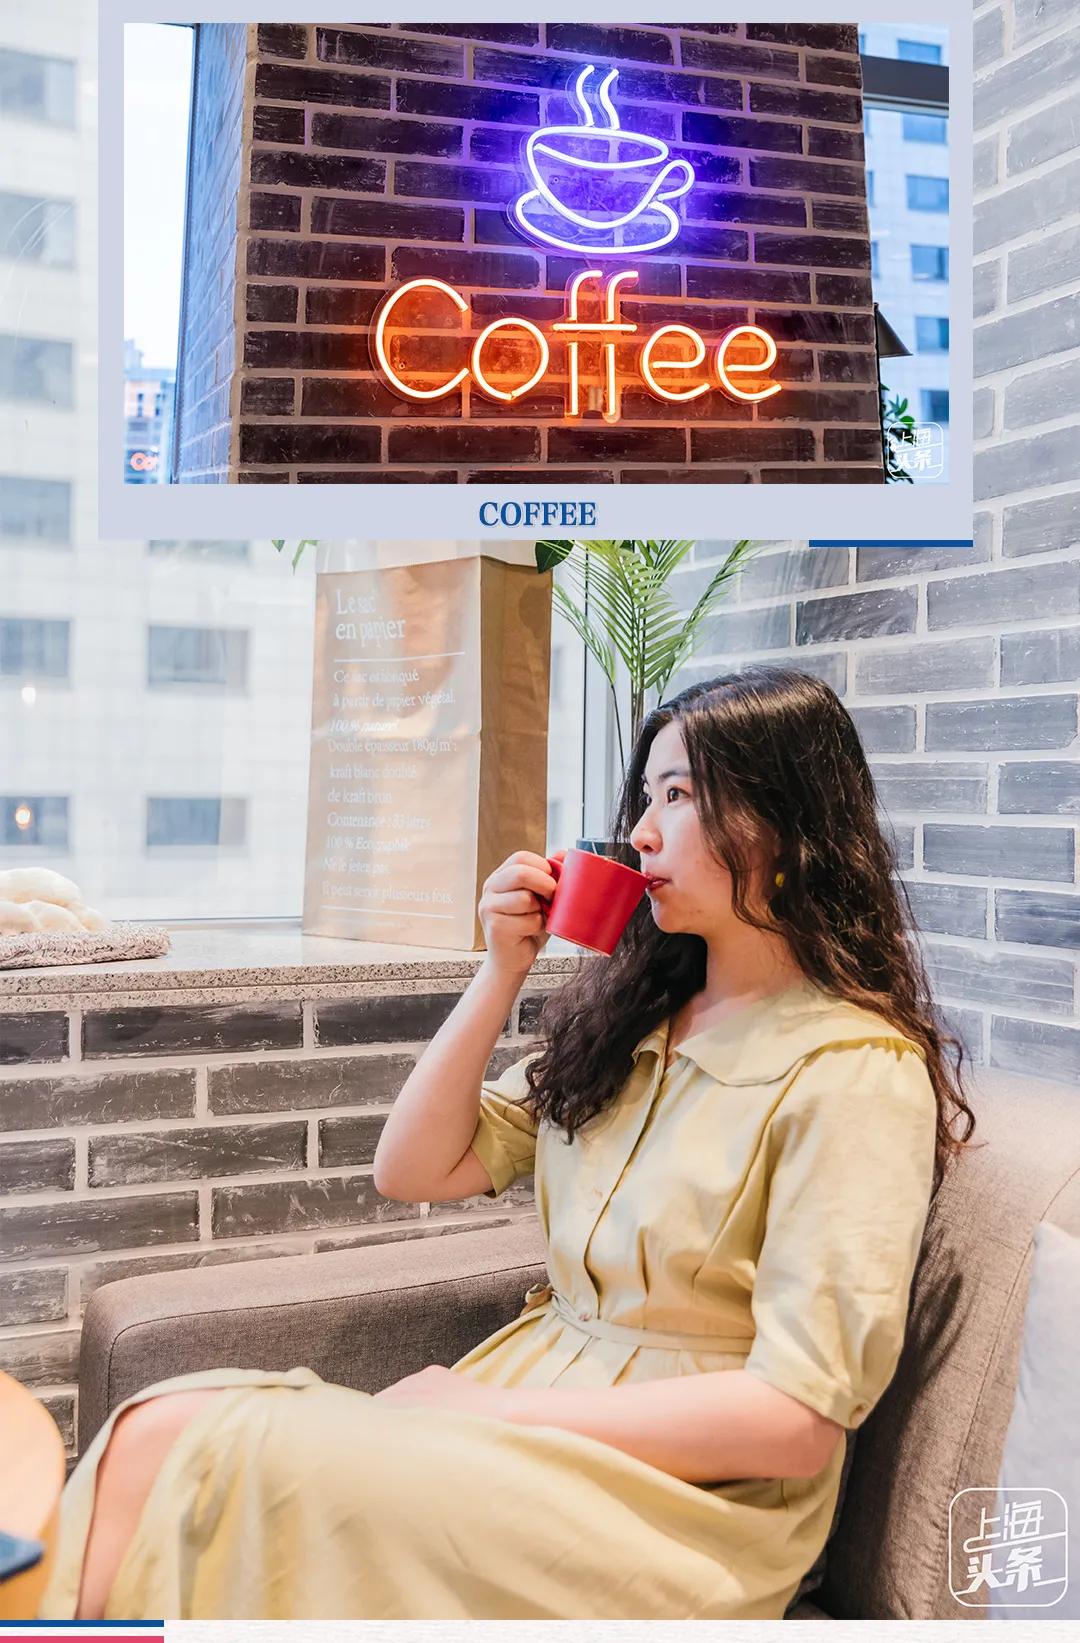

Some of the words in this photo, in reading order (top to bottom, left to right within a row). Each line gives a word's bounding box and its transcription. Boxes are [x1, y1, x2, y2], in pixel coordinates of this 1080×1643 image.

[375, 269, 782, 419] Coffee
[335, 588, 356, 615] Le
[335, 623, 356, 640] en
[360, 615, 407, 648] papier
[372, 690, 385, 707] de
[328, 737, 363, 754] Double
[328, 786, 341, 802] de
